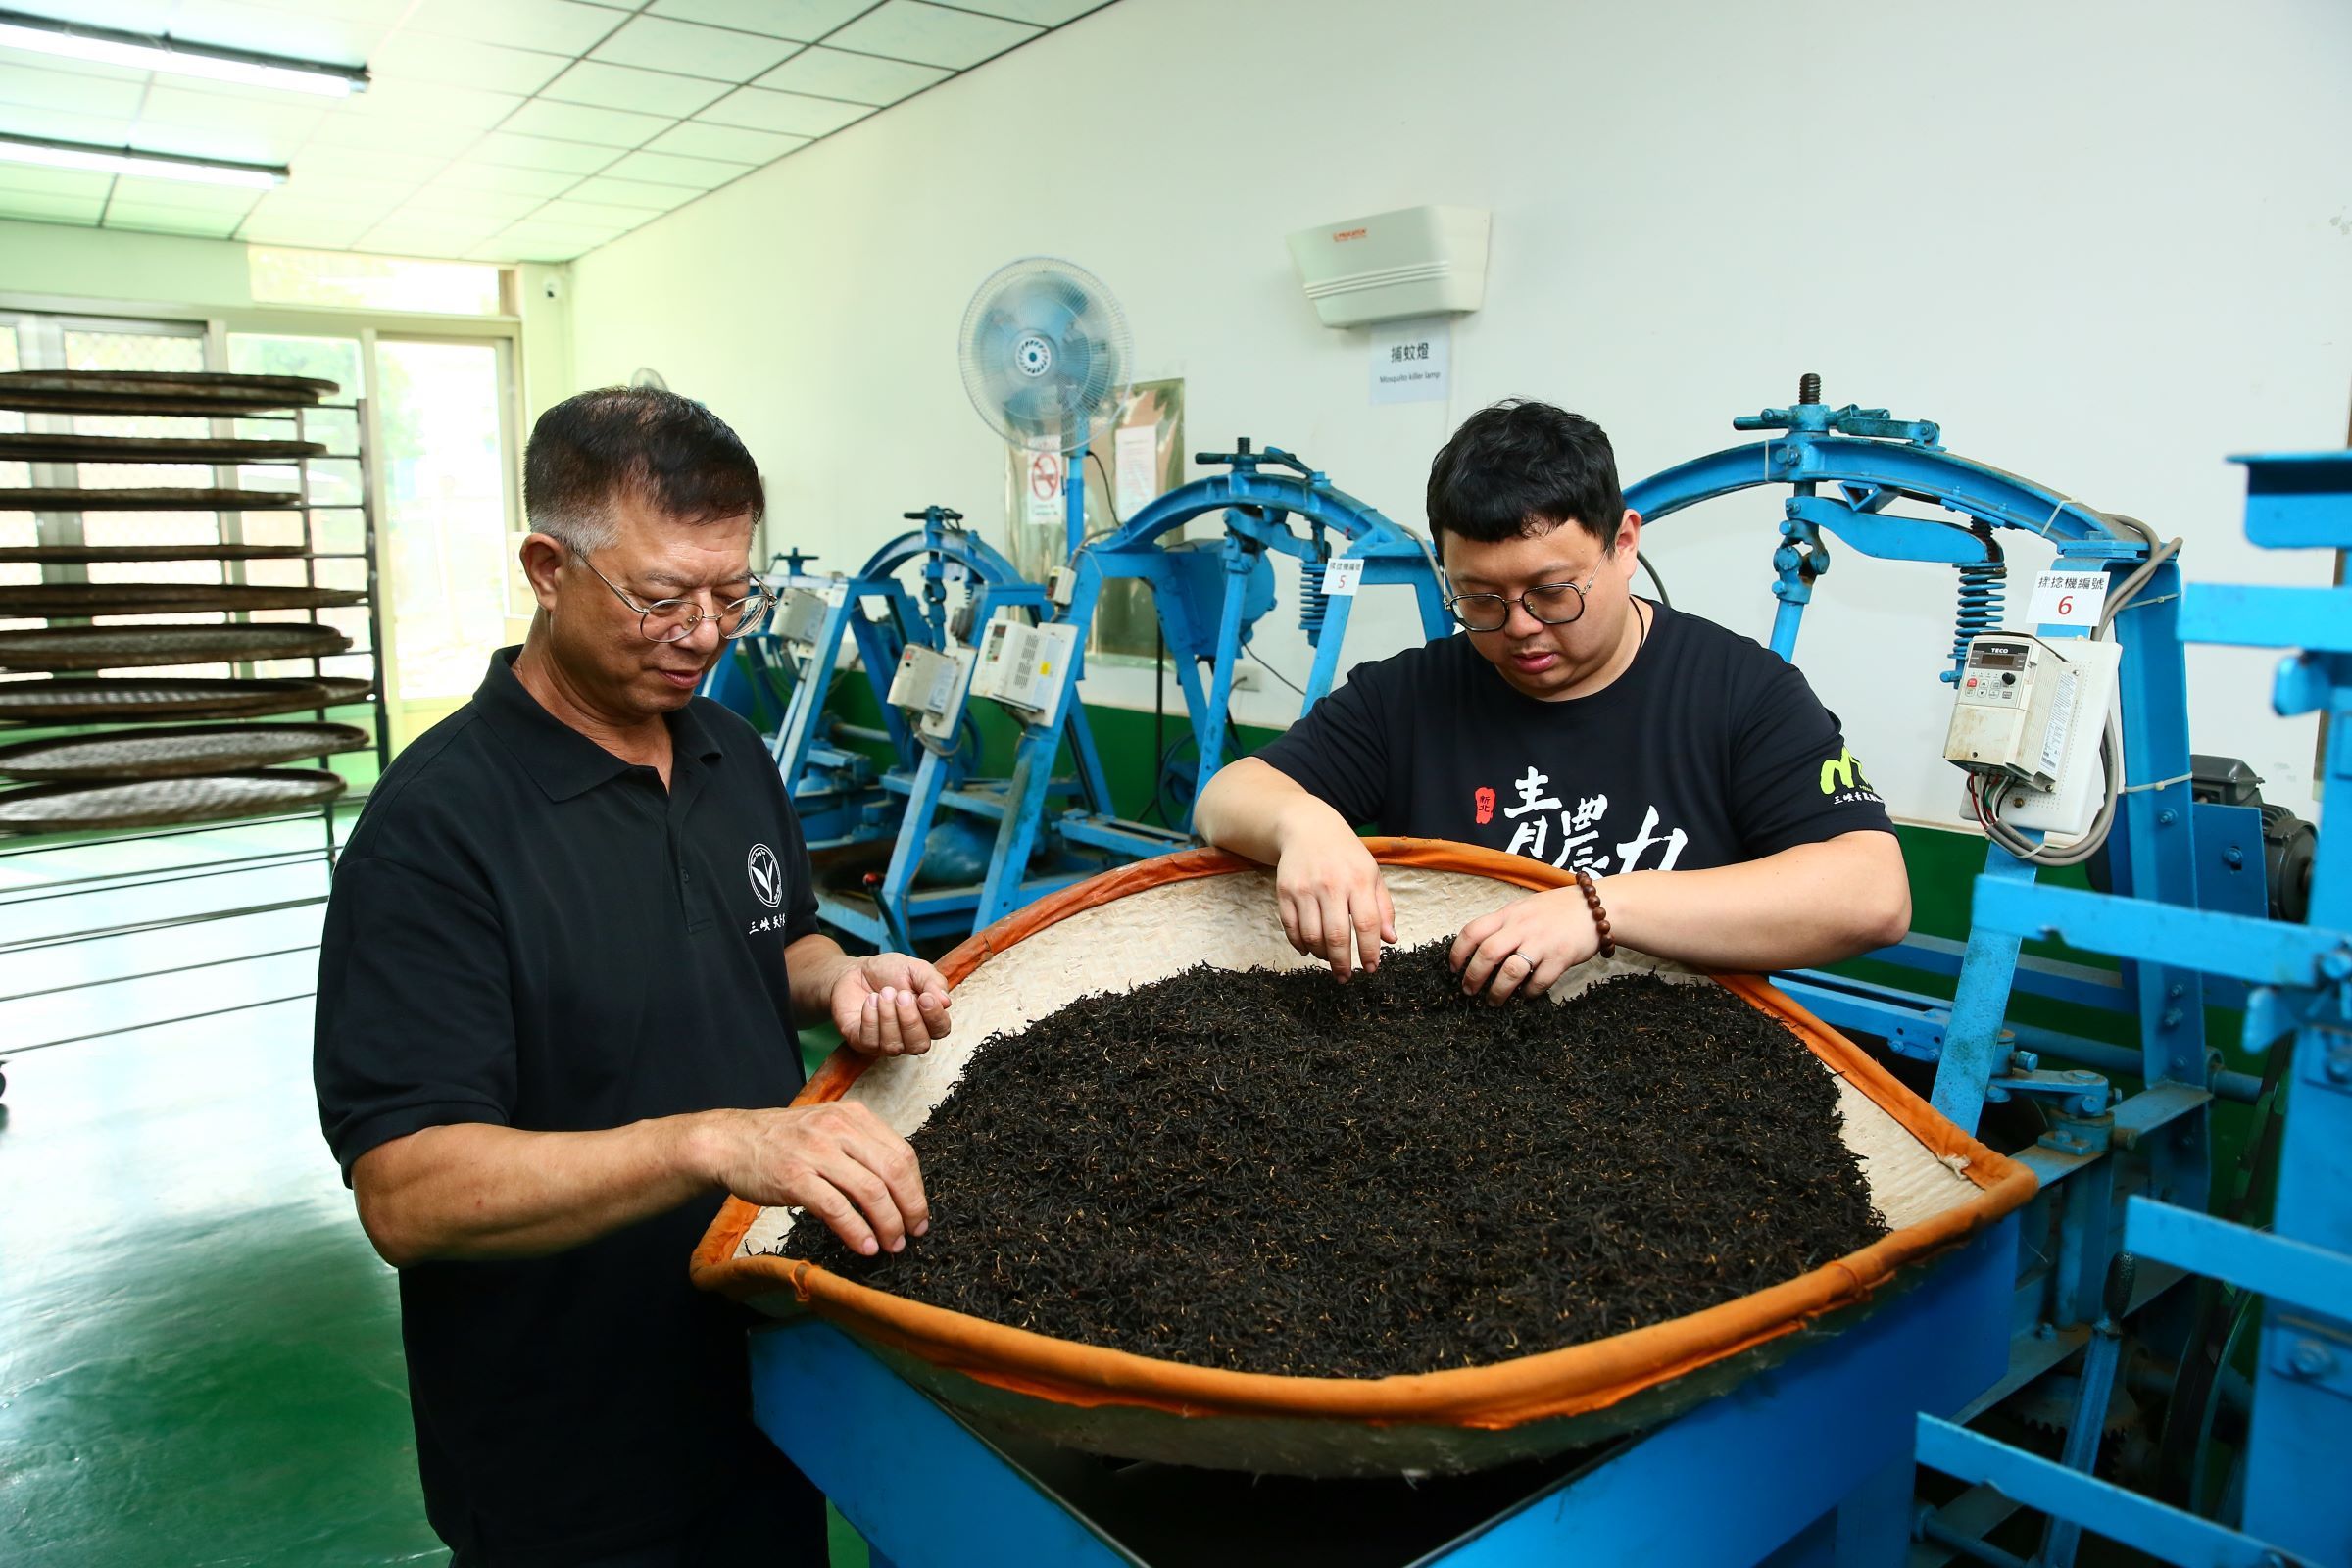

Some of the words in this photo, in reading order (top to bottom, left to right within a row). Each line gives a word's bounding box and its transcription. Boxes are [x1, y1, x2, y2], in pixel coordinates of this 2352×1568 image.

[1390, 342, 1430, 364] 捕蚊燈
[1379, 374, 1408, 384] Mosquito
[1408, 372, 1424, 381] killer
[1424, 370, 1441, 381] lamp
[1338, 574, 1347, 589] 5
[2058, 595, 2074, 615] 6
